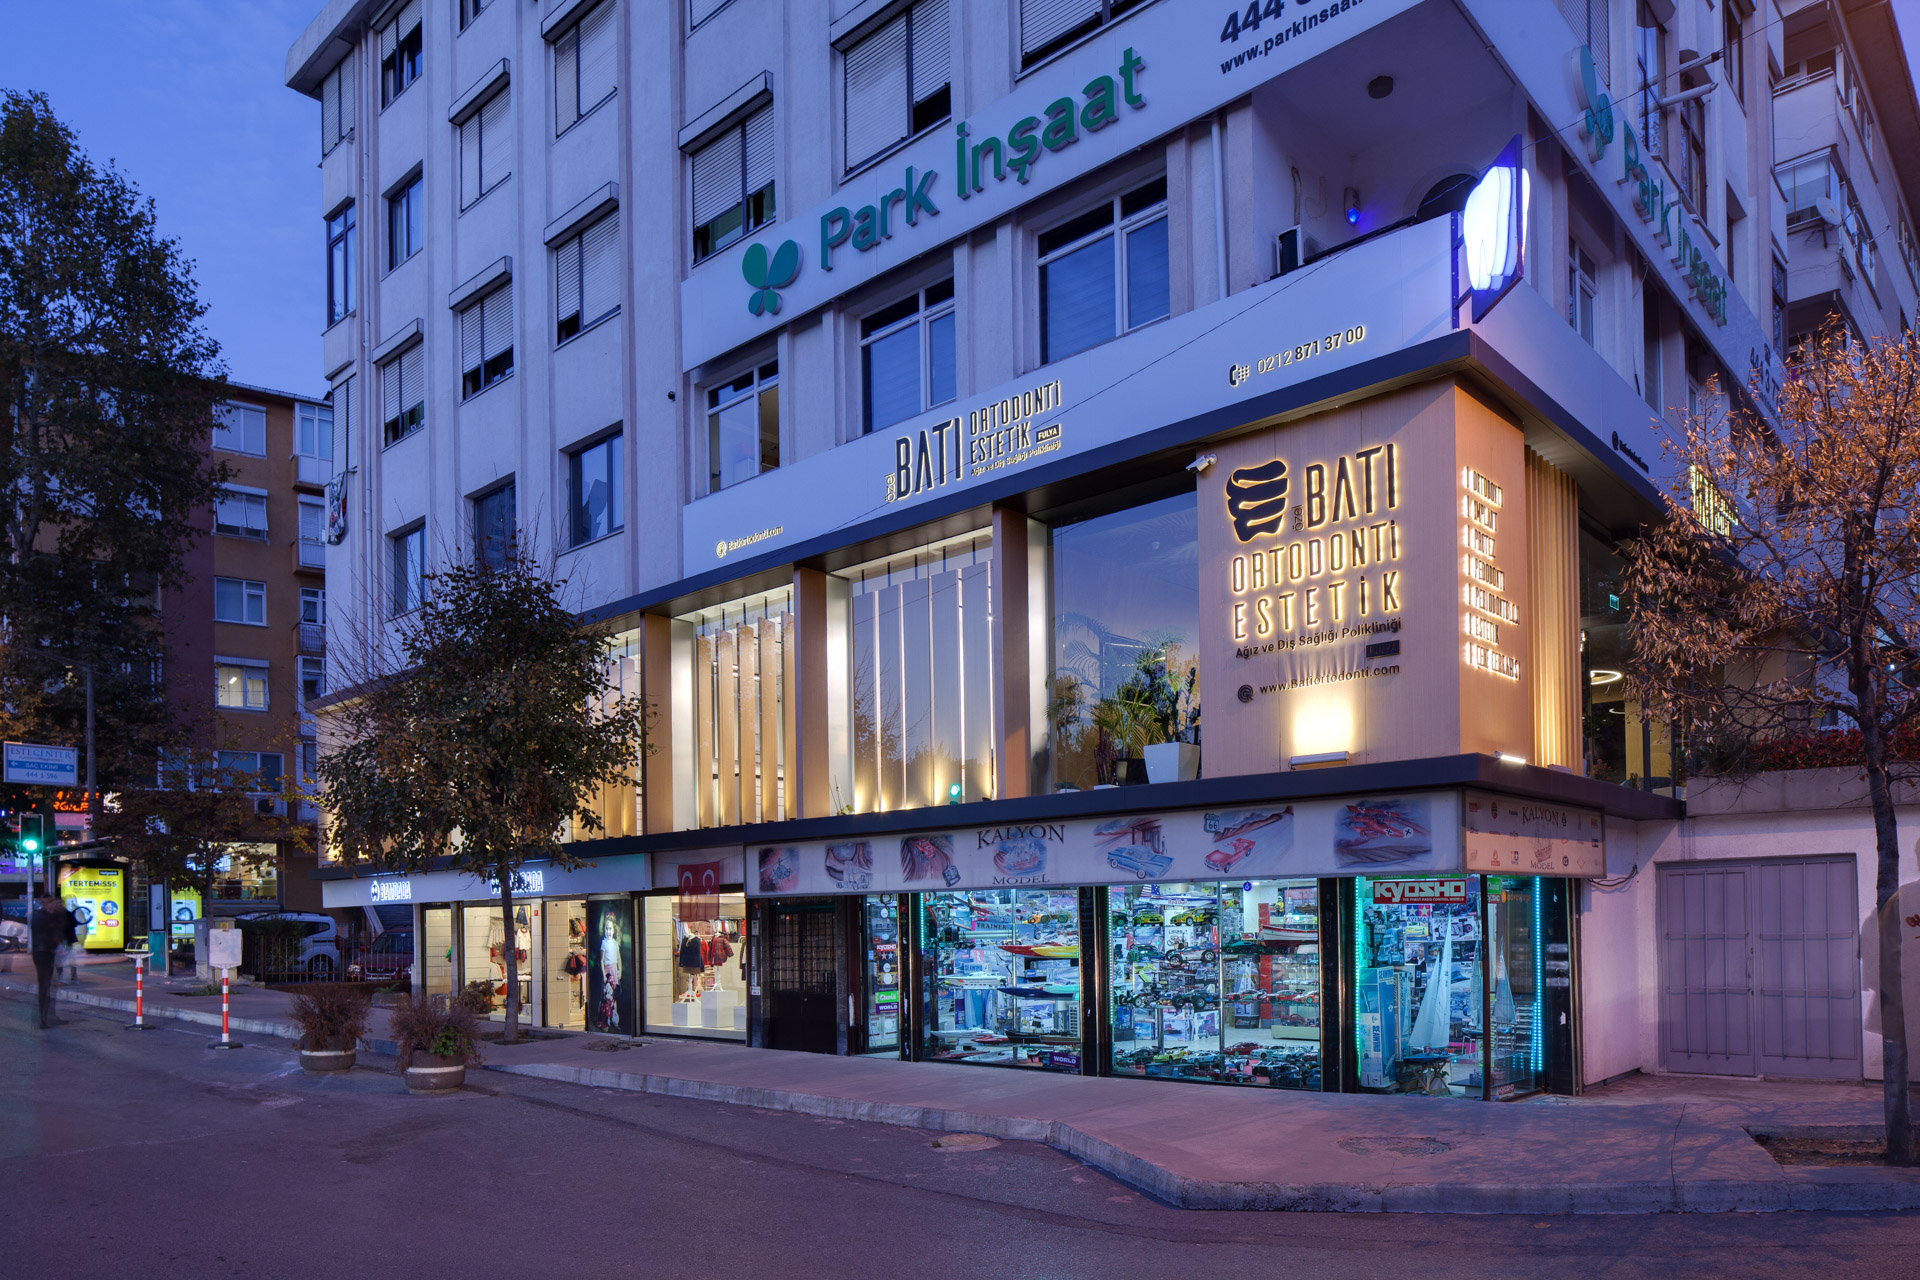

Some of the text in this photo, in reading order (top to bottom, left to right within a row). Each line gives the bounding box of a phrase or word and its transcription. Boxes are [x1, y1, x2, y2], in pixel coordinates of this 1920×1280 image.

[819, 46, 1147, 272] Park İnşaat
[1621, 119, 1673, 248] Park
[1257, 325, 1366, 374] 0212 871 37 00
[1036, 428, 1058, 440] FULYA
[896, 416, 964, 501] BATI
[1305, 443, 1397, 530] BATI
[1292, 504, 1304, 533] özel
[1236, 617, 1402, 660] Ağız ve Diş Sağlığı Polikliniği
[1521, 806, 1560, 829] KALYON
[976, 823, 1065, 850] KALYON
[1530, 860, 1555, 870] MODEL
[992, 875, 1050, 886] MODEL
[1374, 881, 1466, 902] KYOSHO
[1053, 1056, 1077, 1064] WORLD
